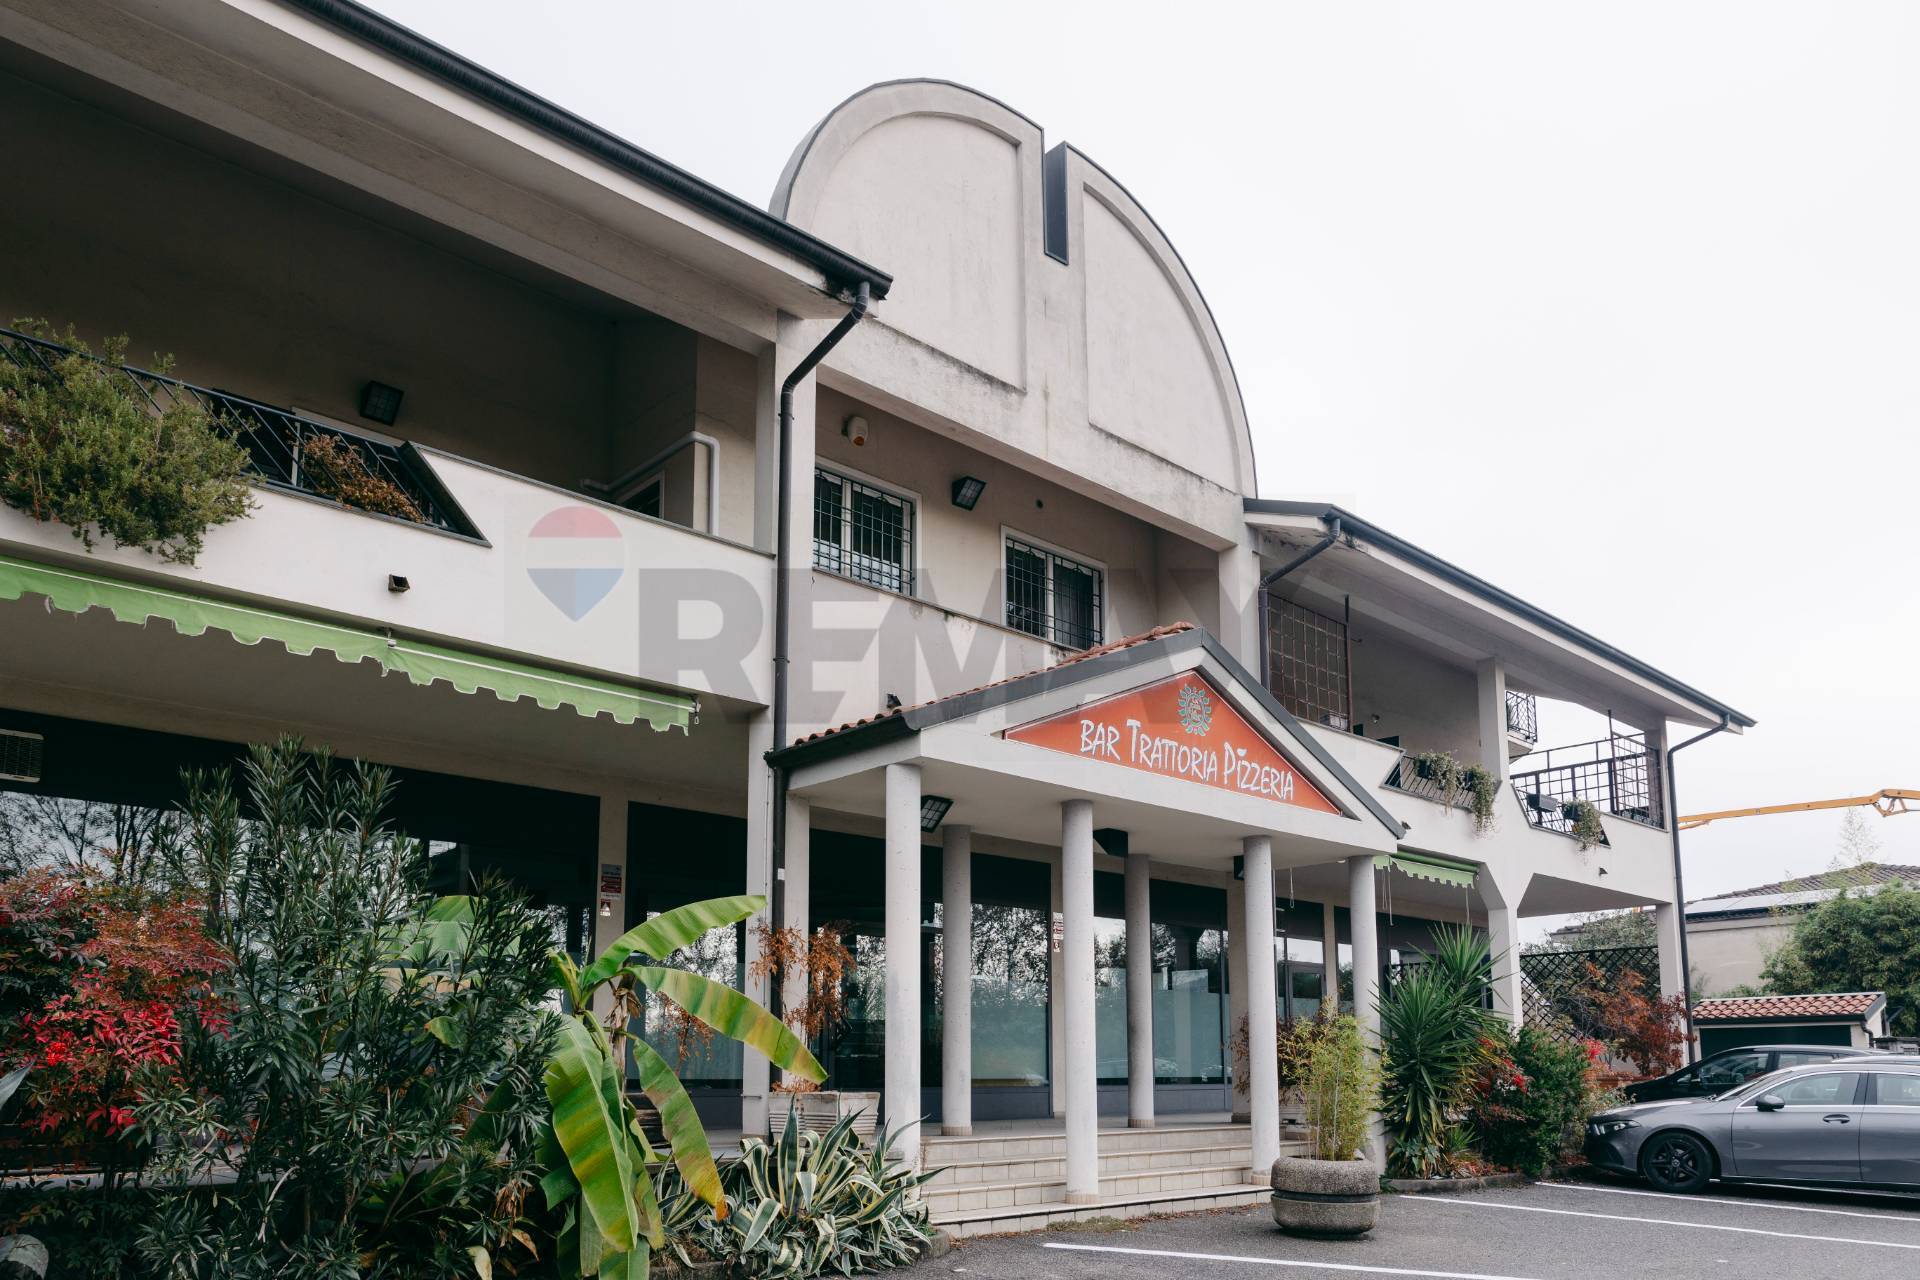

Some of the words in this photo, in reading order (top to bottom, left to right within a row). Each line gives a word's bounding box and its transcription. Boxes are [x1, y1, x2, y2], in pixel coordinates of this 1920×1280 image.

[1080, 719, 1120, 760] BAR
[1126, 718, 1217, 782] TRATTORIA
[1223, 741, 1294, 800] PIZZERIA
